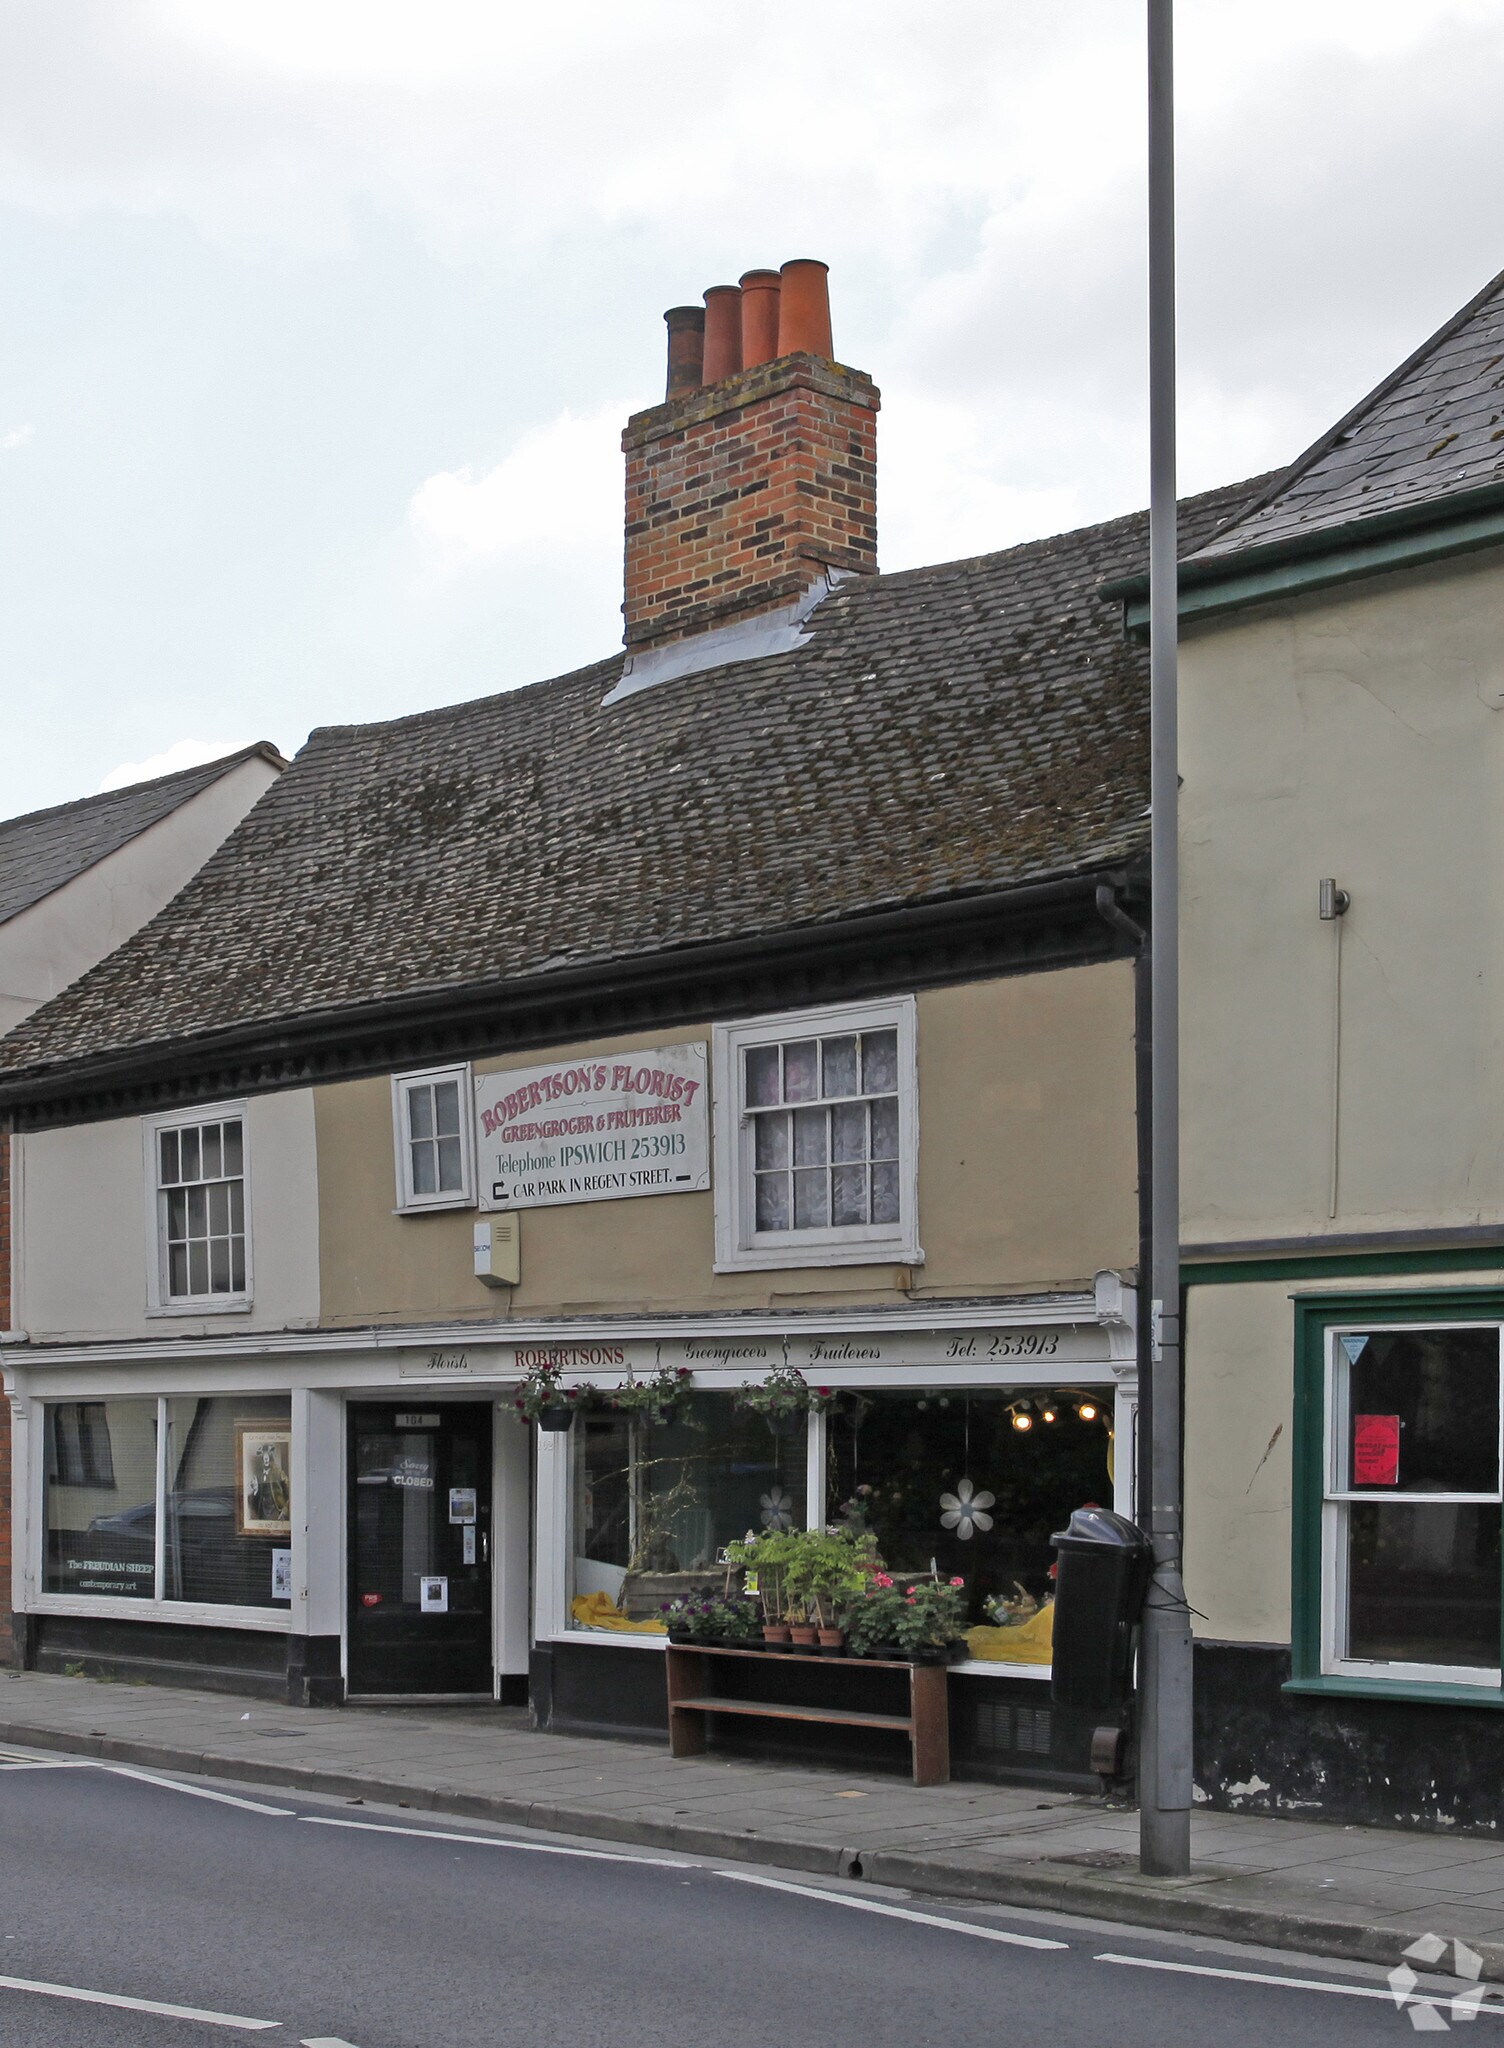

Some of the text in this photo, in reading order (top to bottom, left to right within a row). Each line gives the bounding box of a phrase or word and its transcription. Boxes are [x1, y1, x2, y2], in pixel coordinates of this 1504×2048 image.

[480, 1063, 701, 1137] ROBERTSON'S FLORIST
[596, 1114, 606, 1131] &
[606, 1103, 682, 1130] FRUITERER
[495, 1133, 686, 1176] Telephone IPSWICH 253913
[513, 1168, 672, 1198] CAR PARK IN REGENT STREET.
[514, 1346, 624, 1367] ROBERTSONS
[683, 1340, 768, 1365] Greengrocers
[808, 1340, 881, 1360] Fruiterers
[946, 1334, 1060, 1357] Tel: 253913
[427, 1352, 469, 1370] Florists
[405, 1415, 423, 1425] 104
[394, 1475, 434, 1488] CLOSED
[67, 1560, 154, 1574] The FREUDIAN SHEEP
